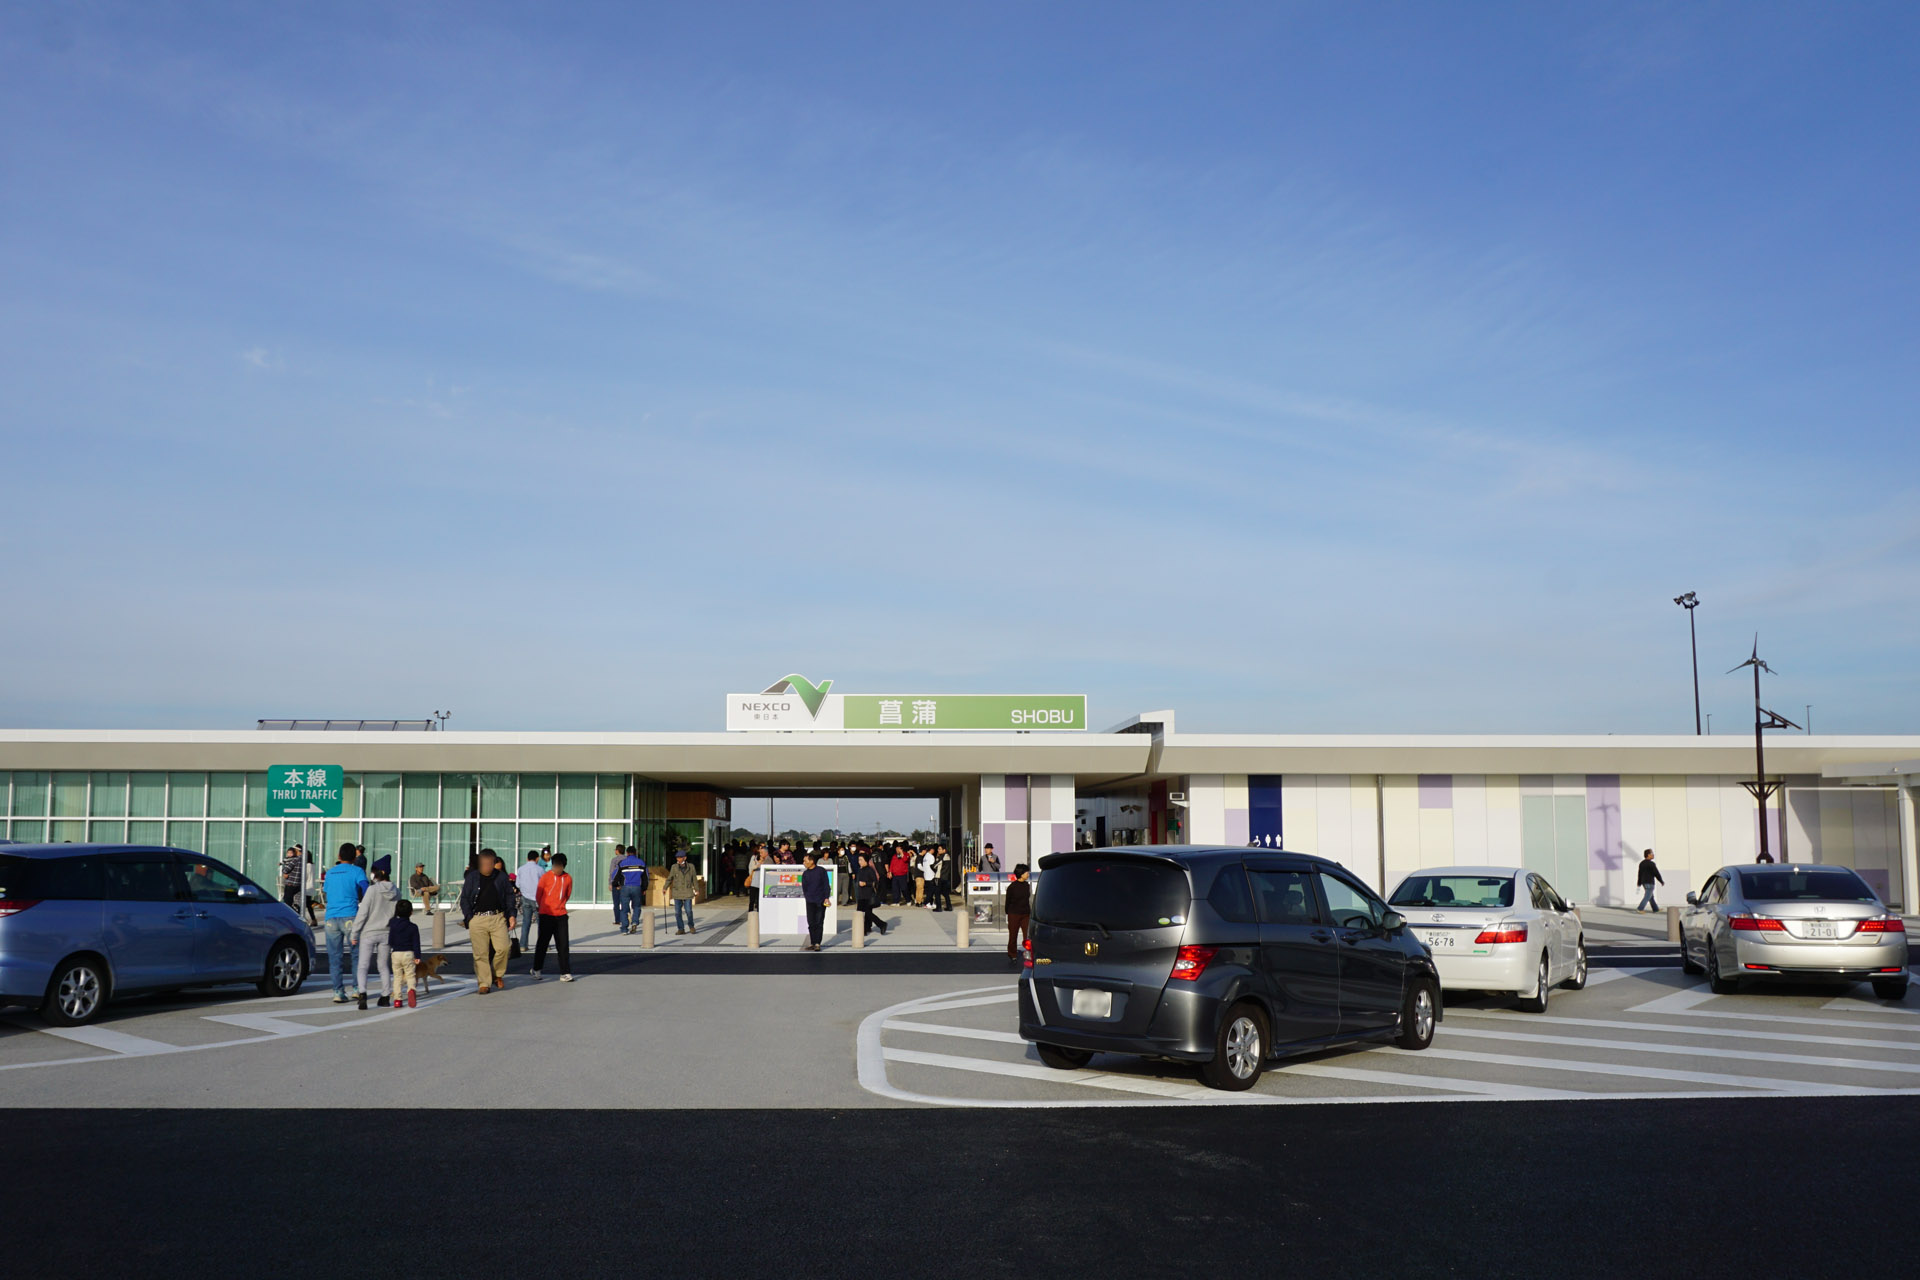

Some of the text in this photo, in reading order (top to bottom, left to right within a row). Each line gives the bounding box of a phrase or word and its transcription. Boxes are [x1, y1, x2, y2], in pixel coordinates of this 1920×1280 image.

[742, 702, 791, 711] NEXCO
[878, 700, 937, 725] 菖蒲
[1011, 709, 1074, 724] SHOBU
[283, 768, 327, 788] 本線
[272, 789, 338, 800] THRU TRAFFIC
[1428, 937, 1455, 947] 56-78
